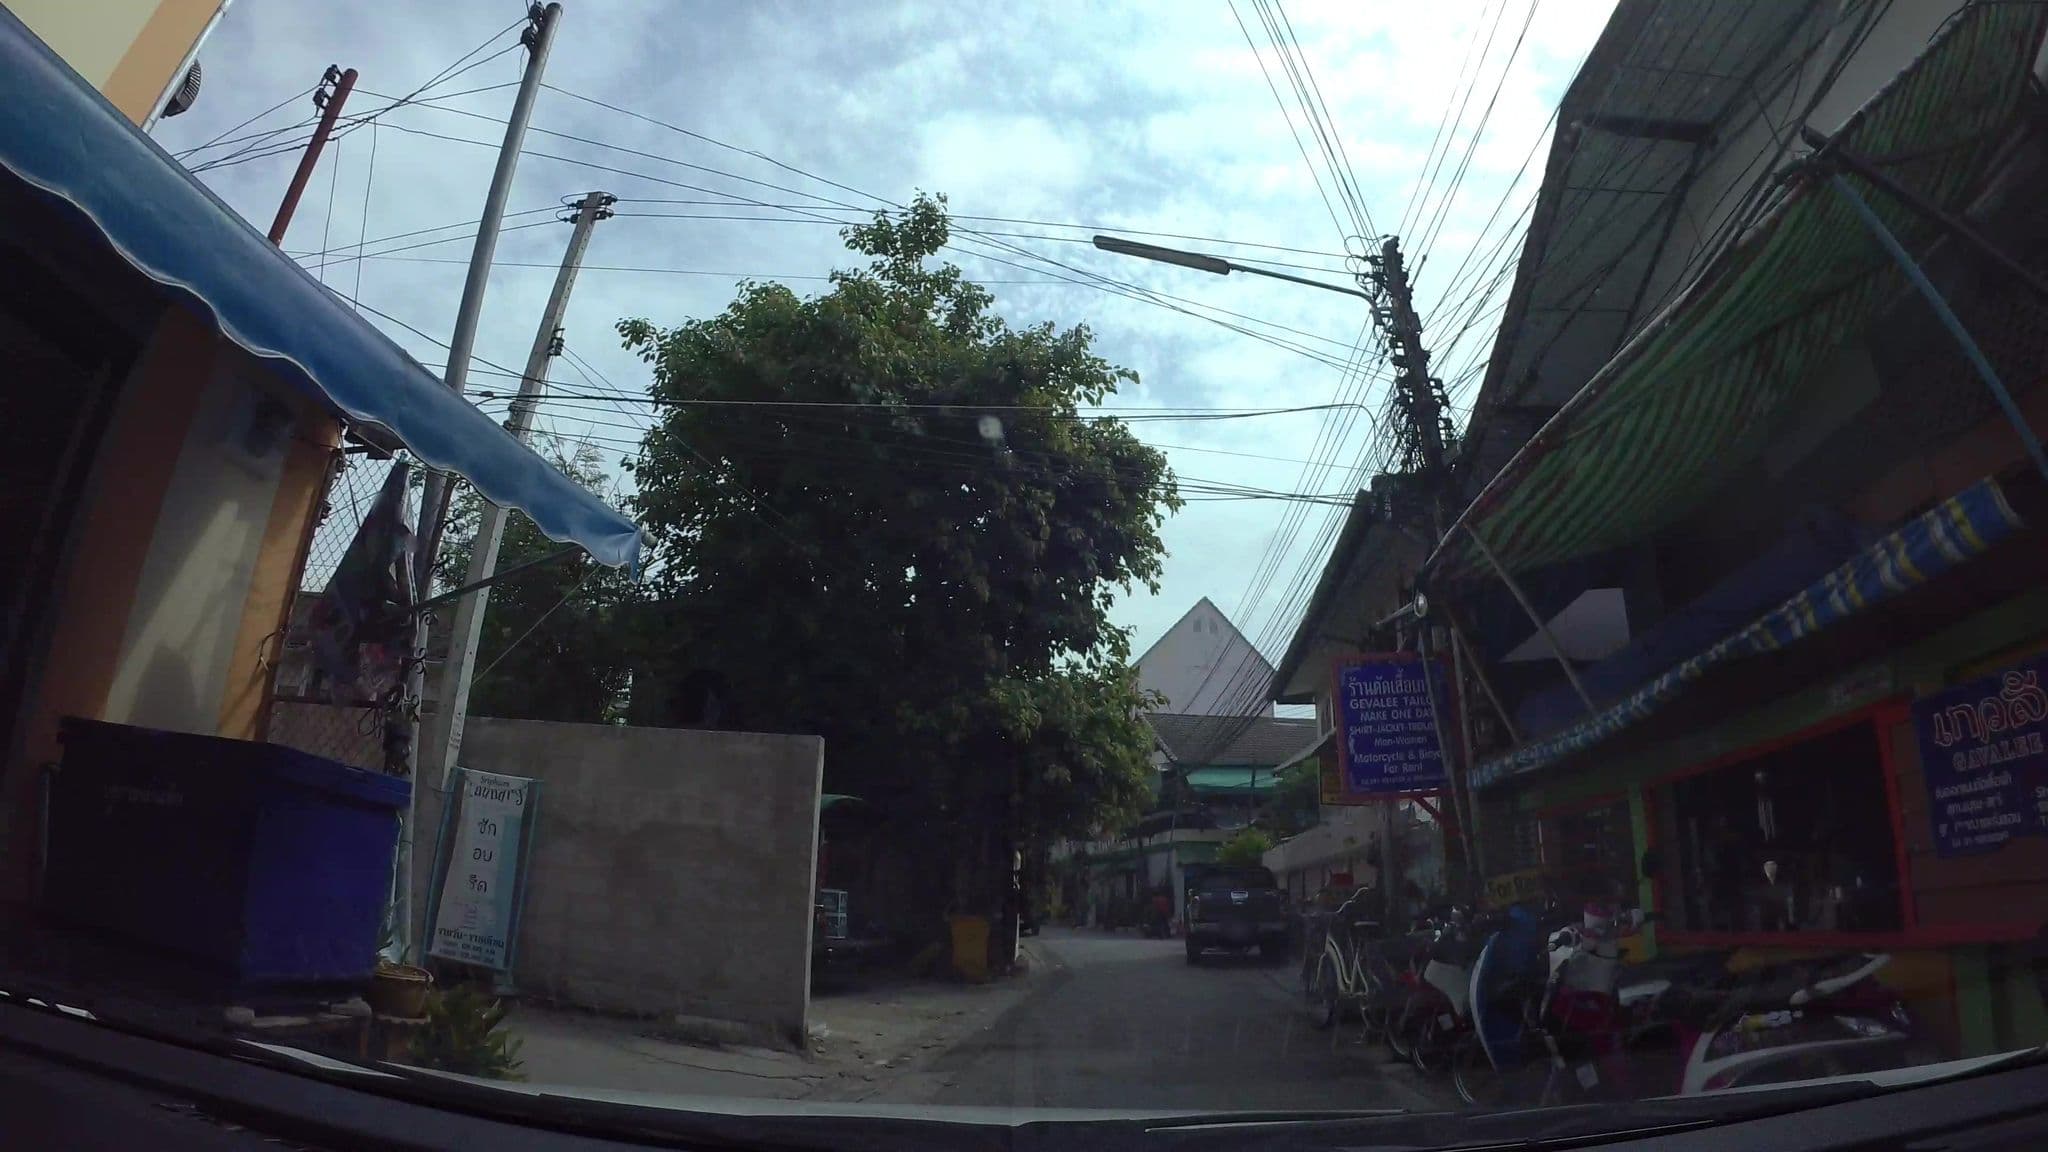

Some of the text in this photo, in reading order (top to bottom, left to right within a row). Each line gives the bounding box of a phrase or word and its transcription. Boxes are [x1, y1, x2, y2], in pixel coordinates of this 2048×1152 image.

[1350, 697, 1399, 710] GEVALEE
[1360, 710, 1387, 722] MAKE
[1391, 709, 1412, 720] ONE
[1384, 762, 1398, 774] For
[473, 847, 493, 862] อบ
